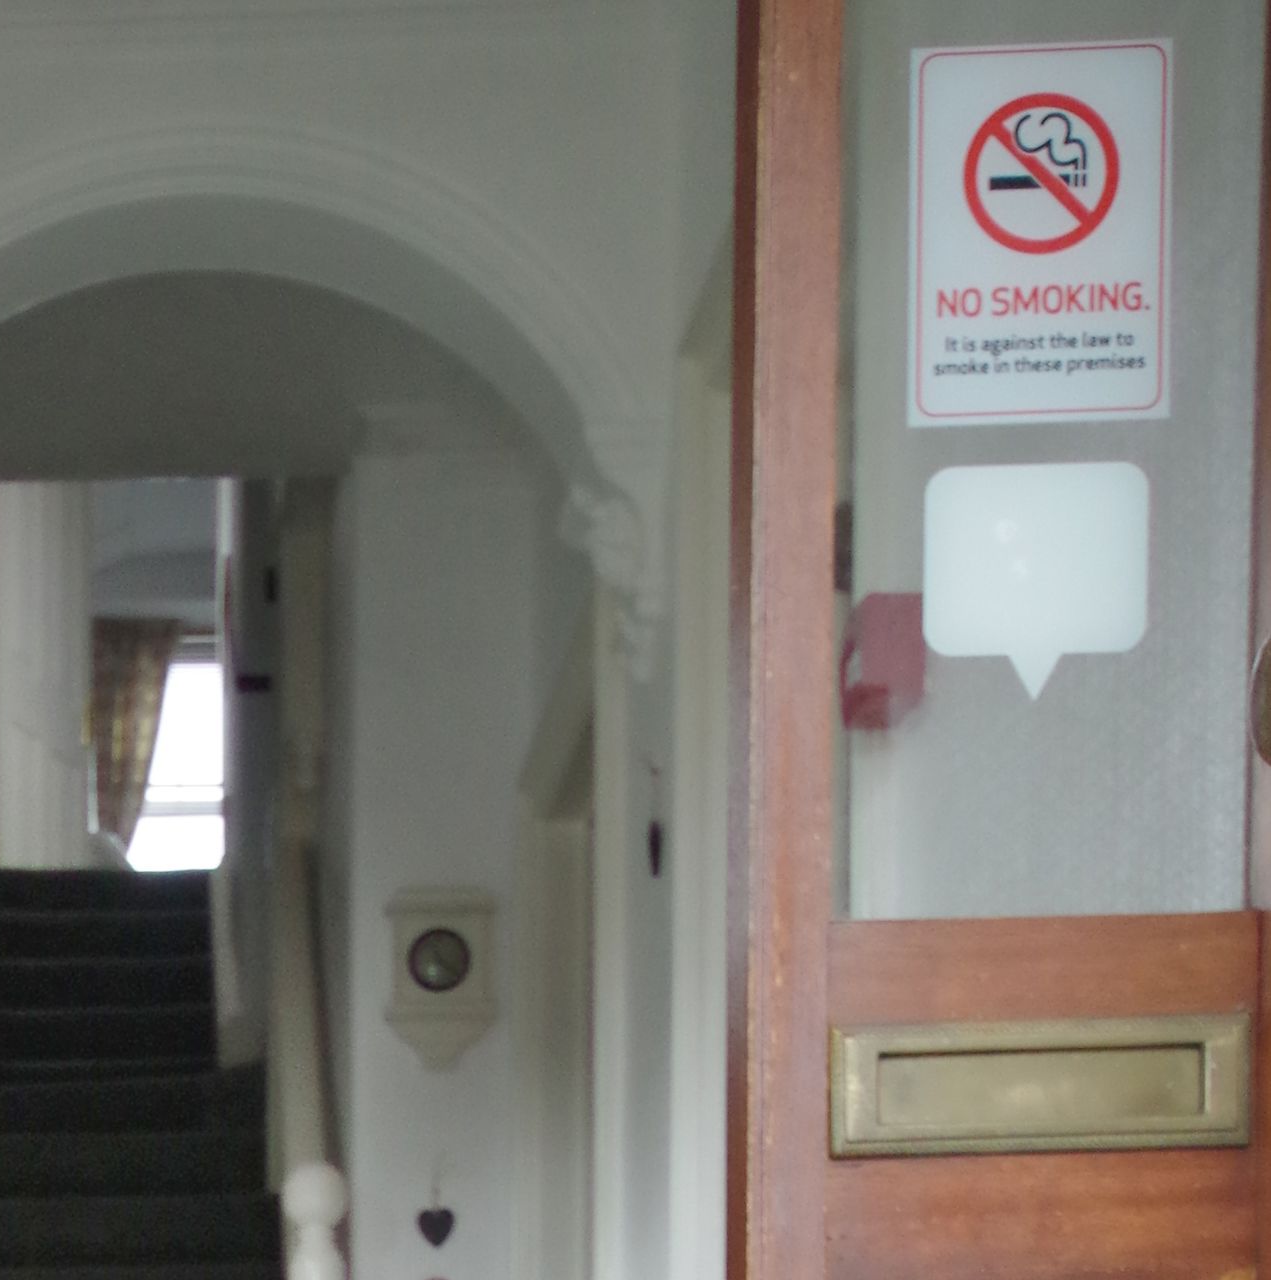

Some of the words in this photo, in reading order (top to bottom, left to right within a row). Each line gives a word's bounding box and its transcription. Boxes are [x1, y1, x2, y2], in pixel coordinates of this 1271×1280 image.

[936, 288, 982, 318] NO
[991, 282, 1150, 316] SMOKING.
[945, 337, 958, 352] It
[962, 336, 975, 351] is
[981, 333, 1044, 357] against
[1050, 332, 1077, 349] the
[1082, 331, 1110, 348] law
[1116, 332, 1134, 347] to
[934, 357, 989, 375] smoke
[994, 358, 1009, 373] in
[1014, 356, 1061, 373] these
[1066, 354, 1146, 375] premises
